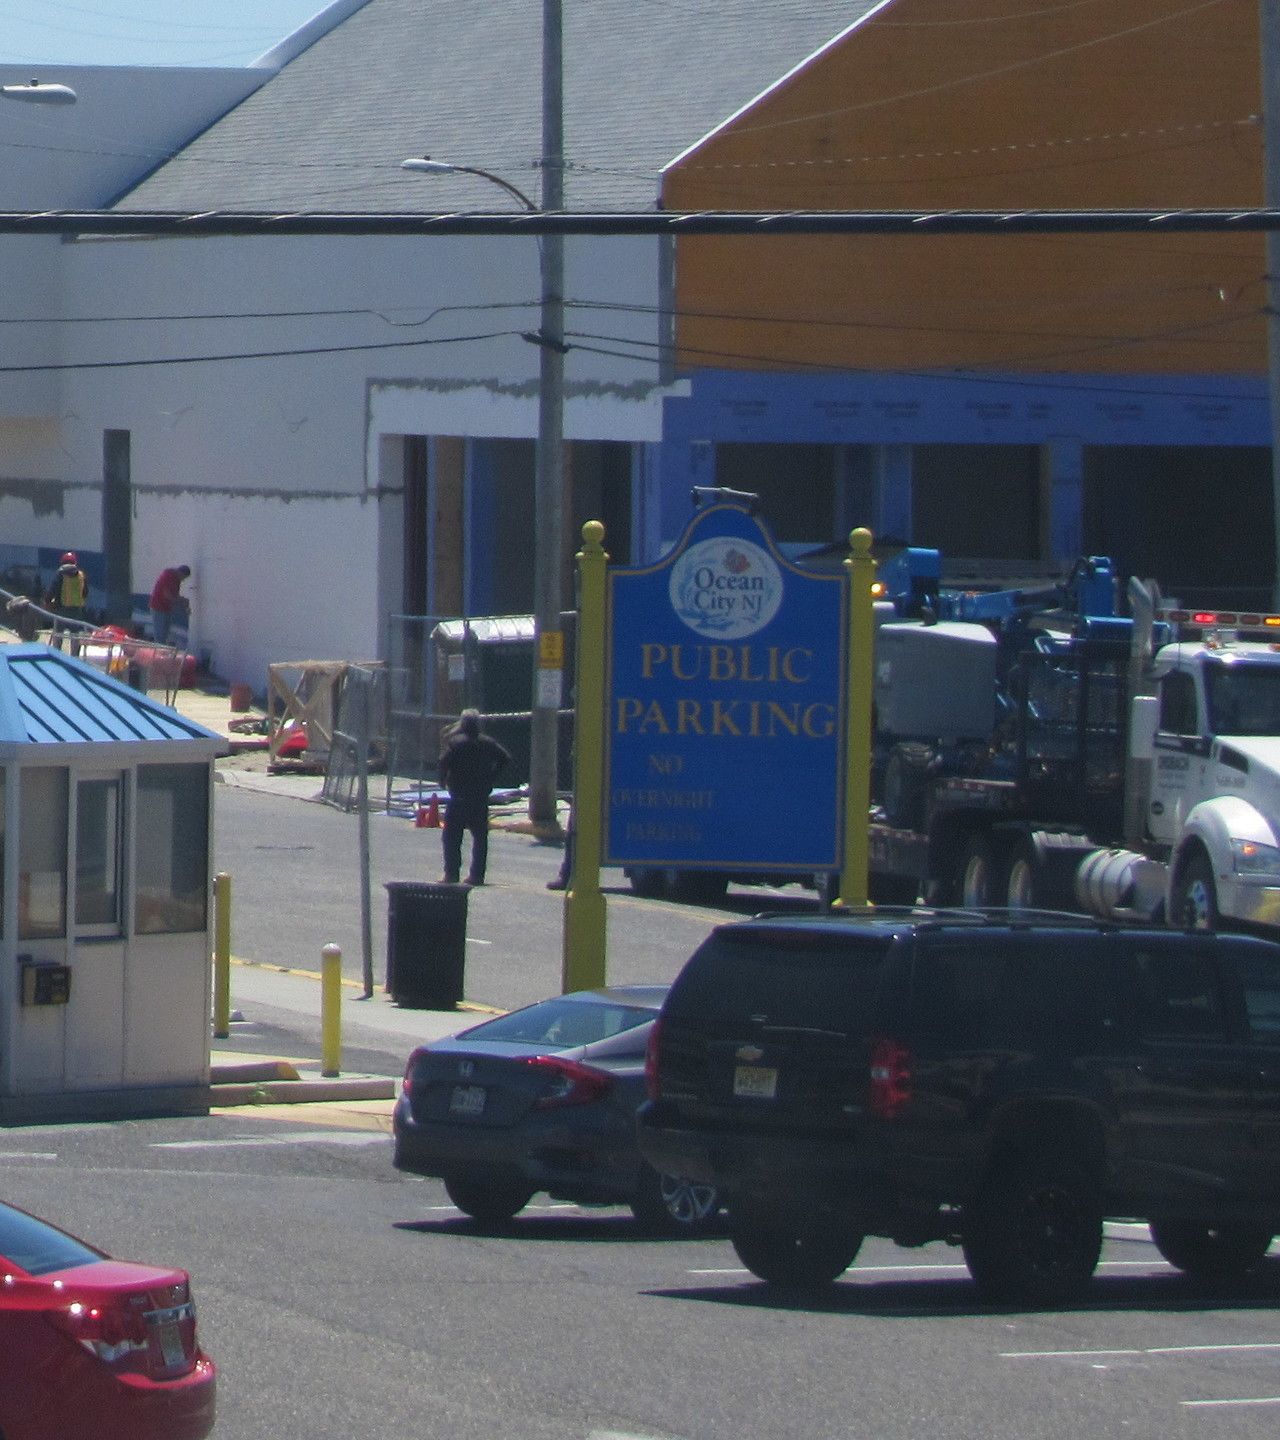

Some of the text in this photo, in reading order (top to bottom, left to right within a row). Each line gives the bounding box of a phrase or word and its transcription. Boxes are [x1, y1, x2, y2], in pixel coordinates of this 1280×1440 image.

[694, 567, 765, 590] Ocean
[694, 589, 763, 616] City NJ
[640, 642, 814, 683] PUBLIC
[616, 698, 835, 738] PARKING
[649, 754, 683, 775] NO
